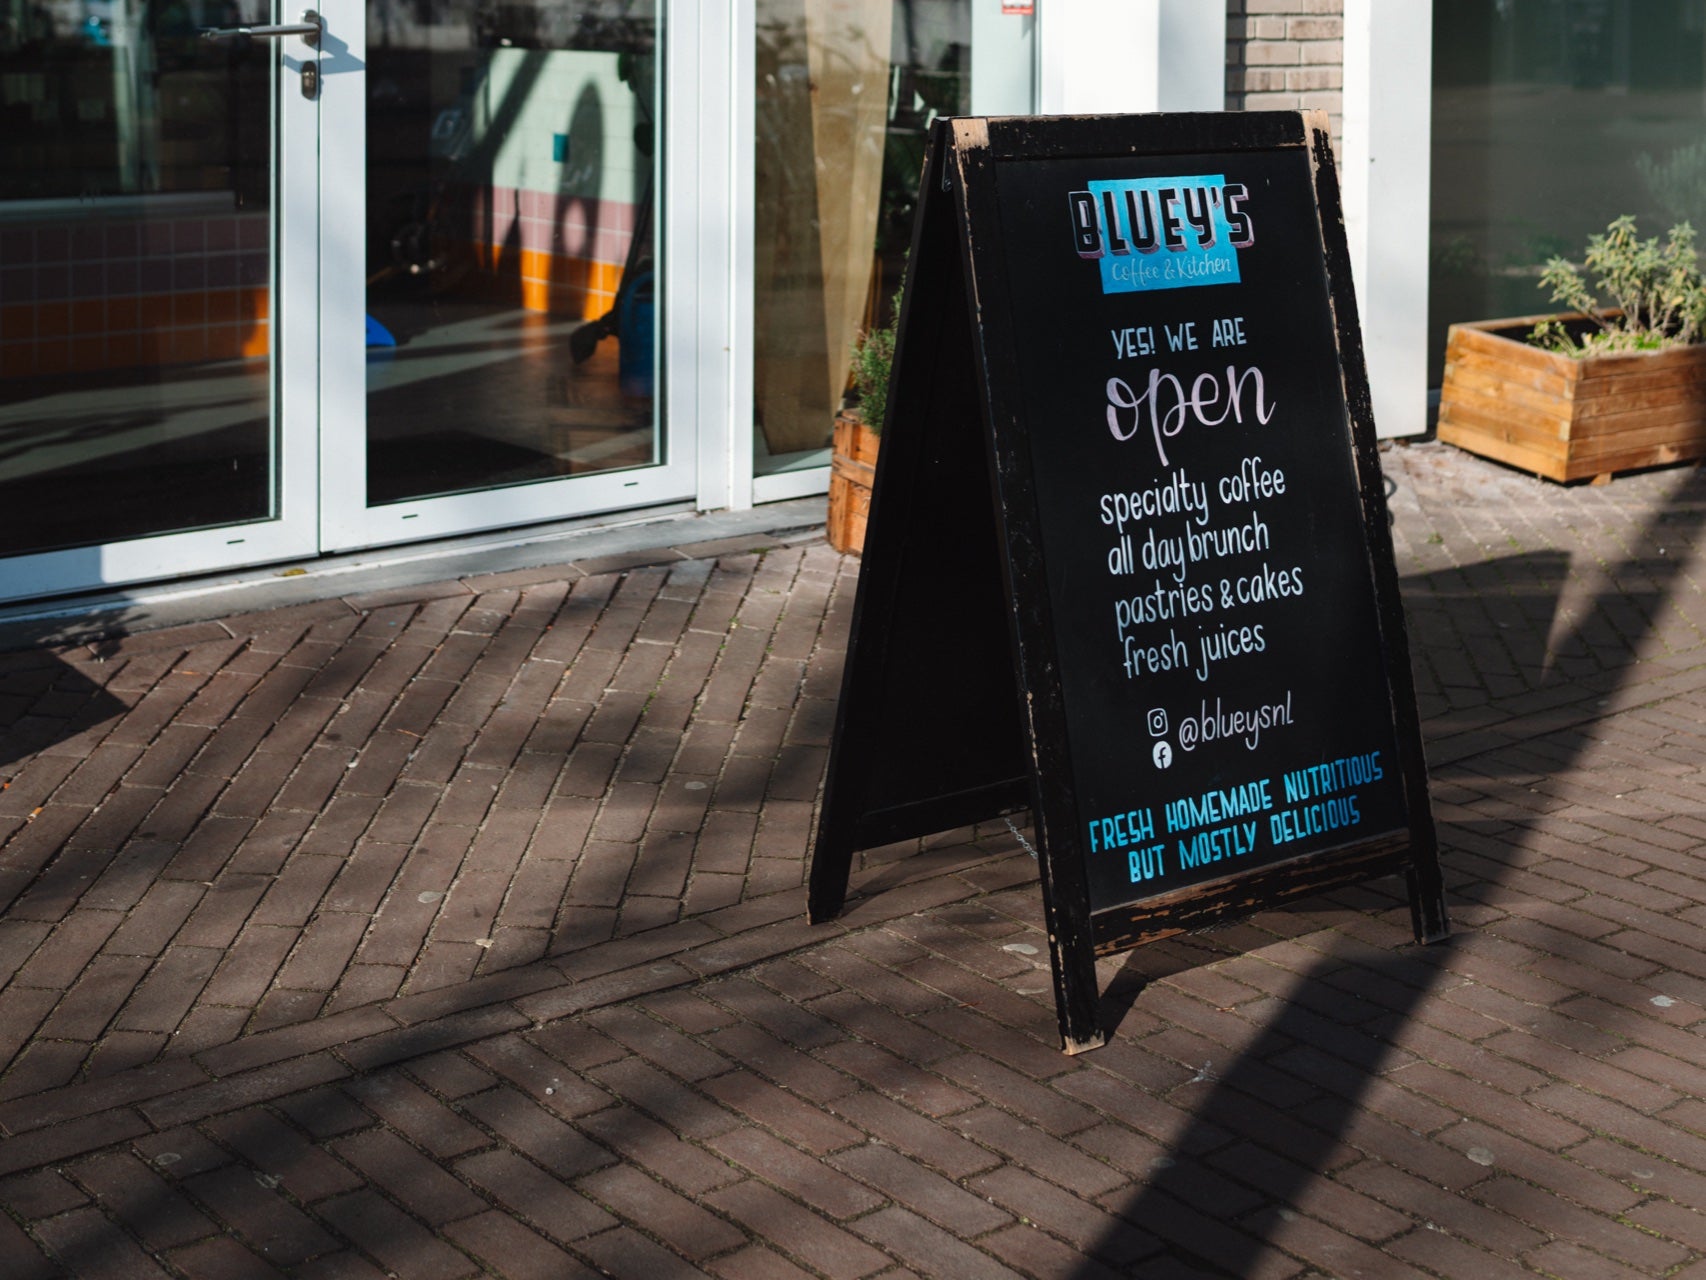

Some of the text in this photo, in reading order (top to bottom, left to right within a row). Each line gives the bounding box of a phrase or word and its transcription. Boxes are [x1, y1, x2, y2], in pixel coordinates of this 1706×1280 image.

[1068, 184, 1254, 259] BLUEY'S
[1163, 258, 1175, 280] &
[1176, 253, 1231, 282] Kitchen
[1111, 317, 1247, 359] YES! WE ARE
[1106, 365, 1276, 467] open
[1100, 456, 1286, 534] specialty coffee
[1108, 510, 1269, 583] all day brunch
[1115, 562, 1304, 642] pastries & cakes
[1123, 623, 1266, 682] fresh juices
[1178, 690, 1294, 751] @blueysnl
[1089, 751, 1384, 853] FRESH HOMEMADE NUTRITIOUS
[1128, 794, 1361, 883] BUT MOSTLY DELICIOUS
